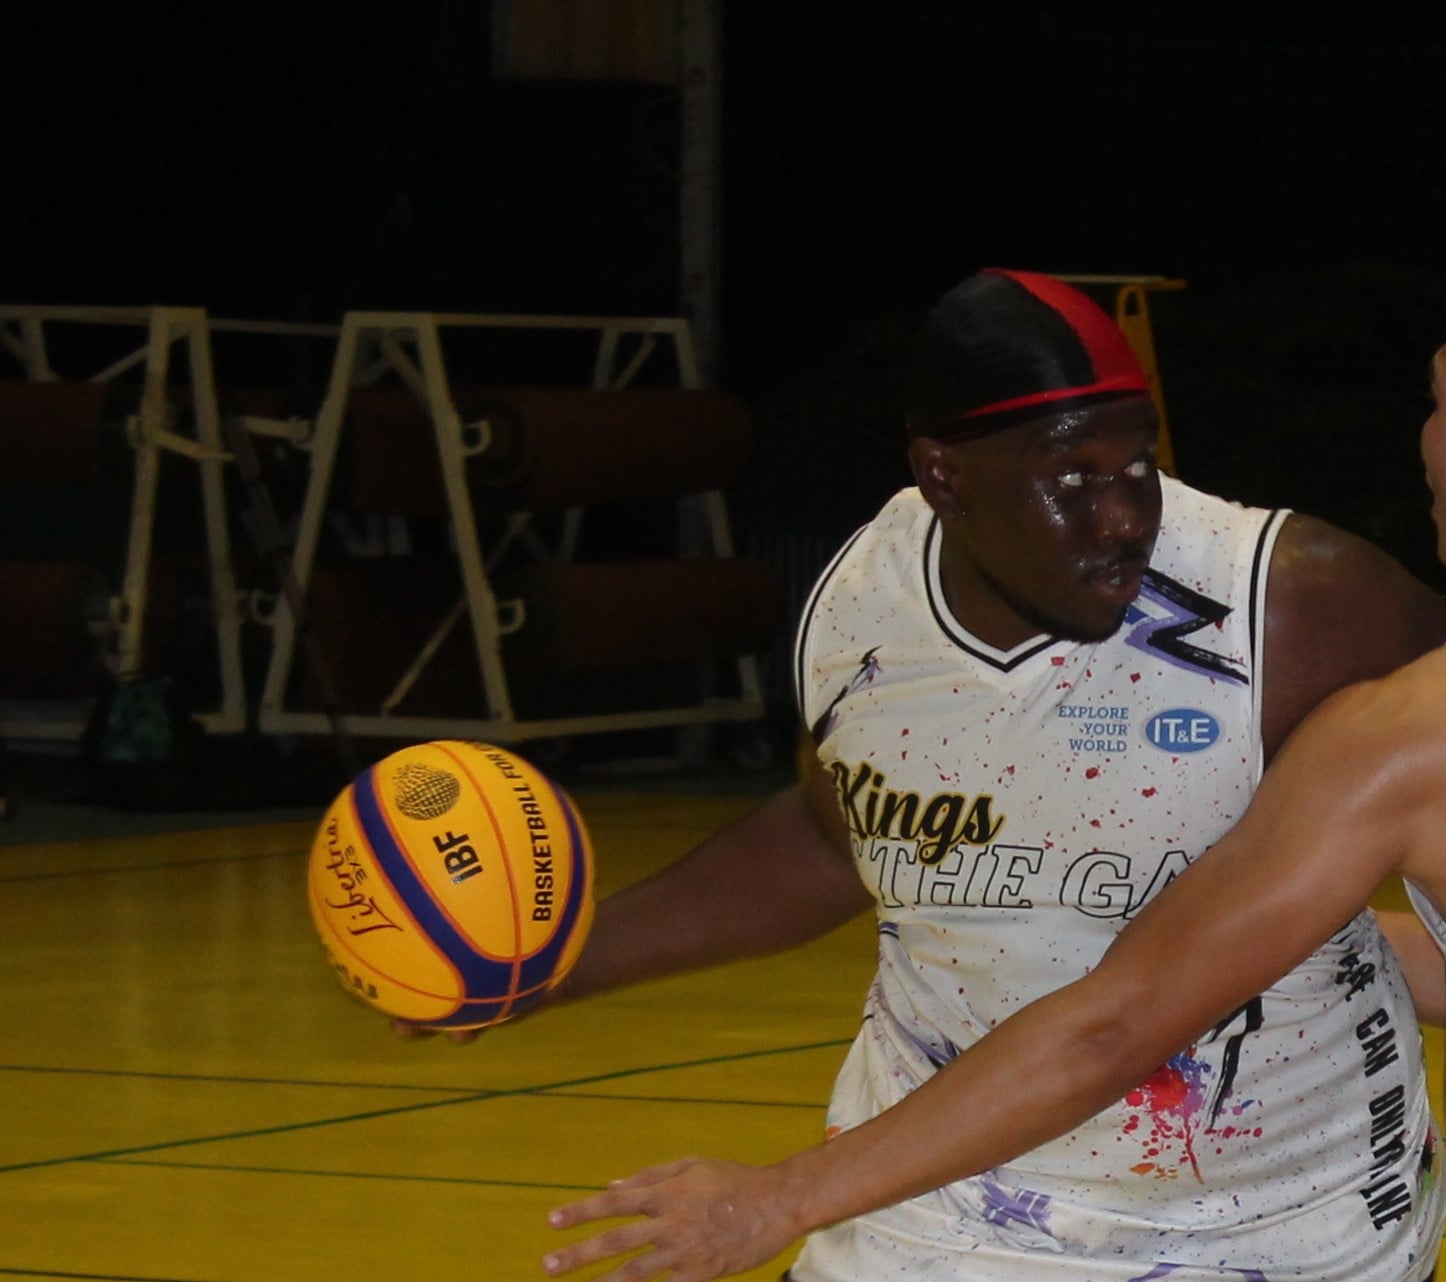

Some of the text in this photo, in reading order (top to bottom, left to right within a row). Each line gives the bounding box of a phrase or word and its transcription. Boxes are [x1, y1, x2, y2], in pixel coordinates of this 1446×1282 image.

[1058, 705, 1129, 720] EXPLORE
[1083, 722, 1128, 736] YOUR
[1153, 717, 1211, 744] IT&E
[1069, 738, 1127, 752] WORLD
[831, 761, 1005, 866] Kings
[432, 830, 483, 885] IBF
[513, 783, 553, 922] BASKETBALL
[868, 838, 1213, 920] THE GA
[1356, 1007, 1399, 1077] CAN
